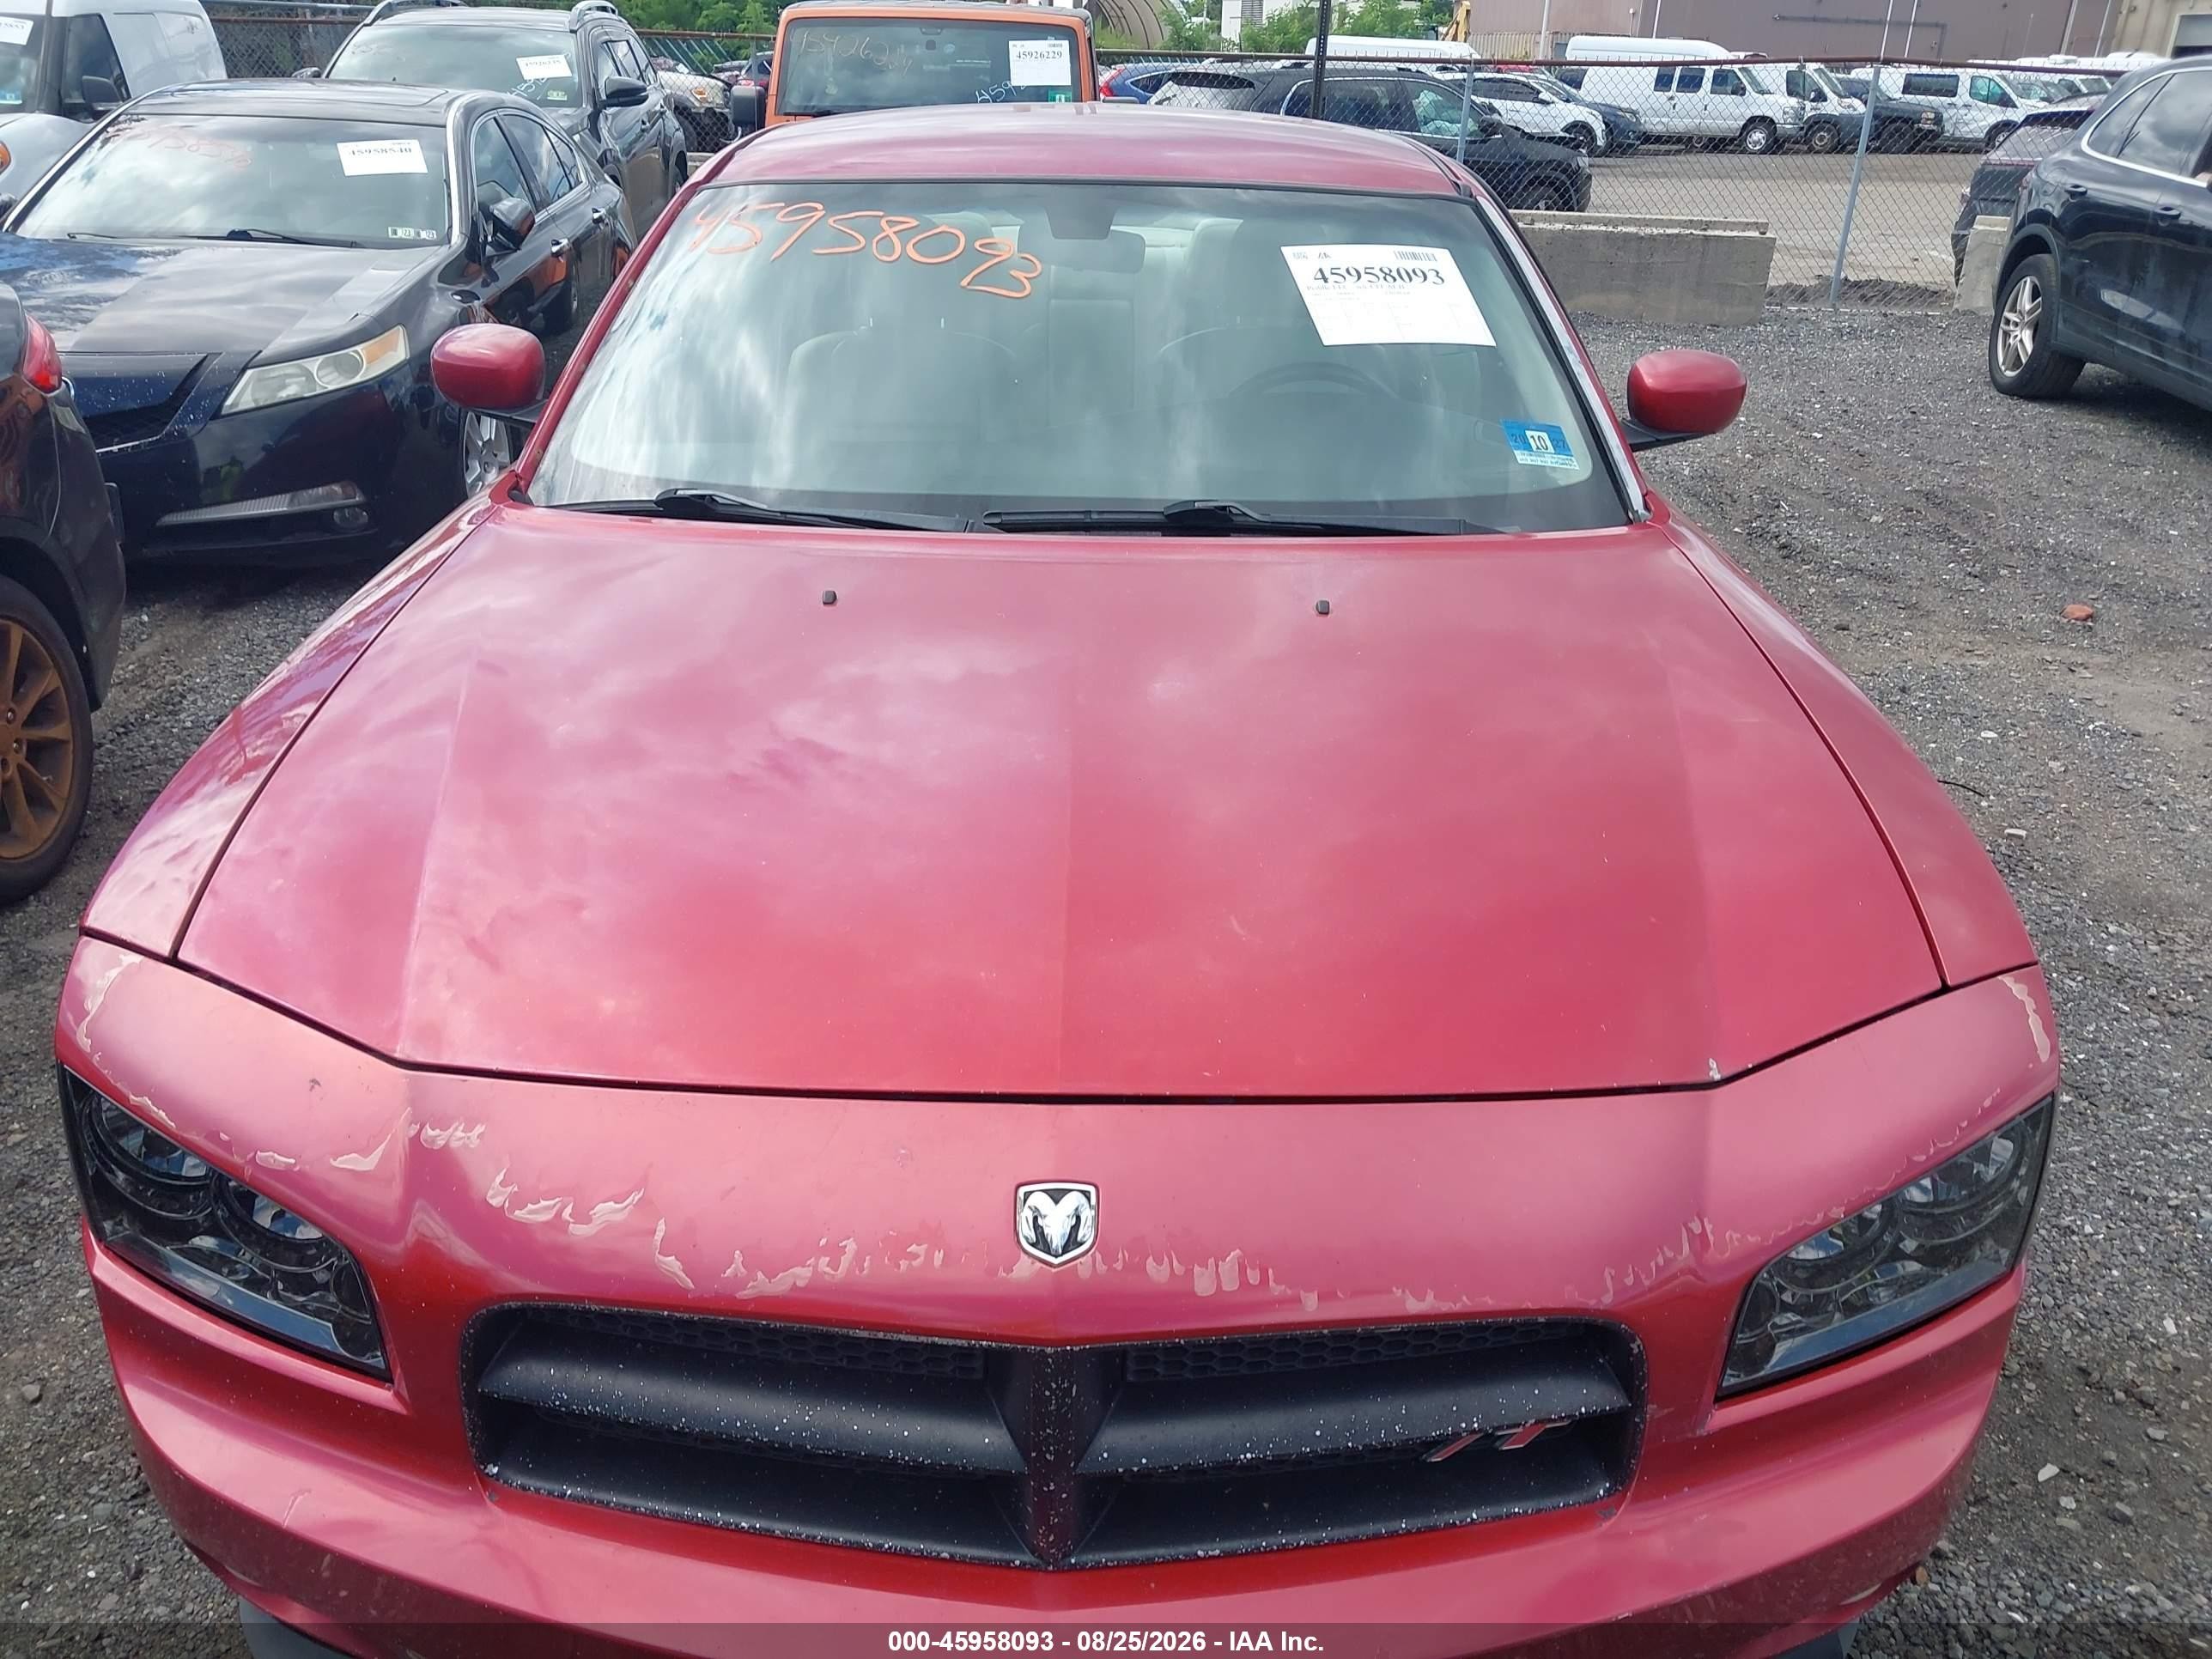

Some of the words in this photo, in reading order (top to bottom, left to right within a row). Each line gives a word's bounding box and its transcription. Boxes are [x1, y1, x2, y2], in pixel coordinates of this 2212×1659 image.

[1016, 51, 1062, 59] 45926229
[689, 201, 1043, 299] 45958093
[1313, 266, 1445, 286] 45958093
[1530, 434, 1548, 451] 10
